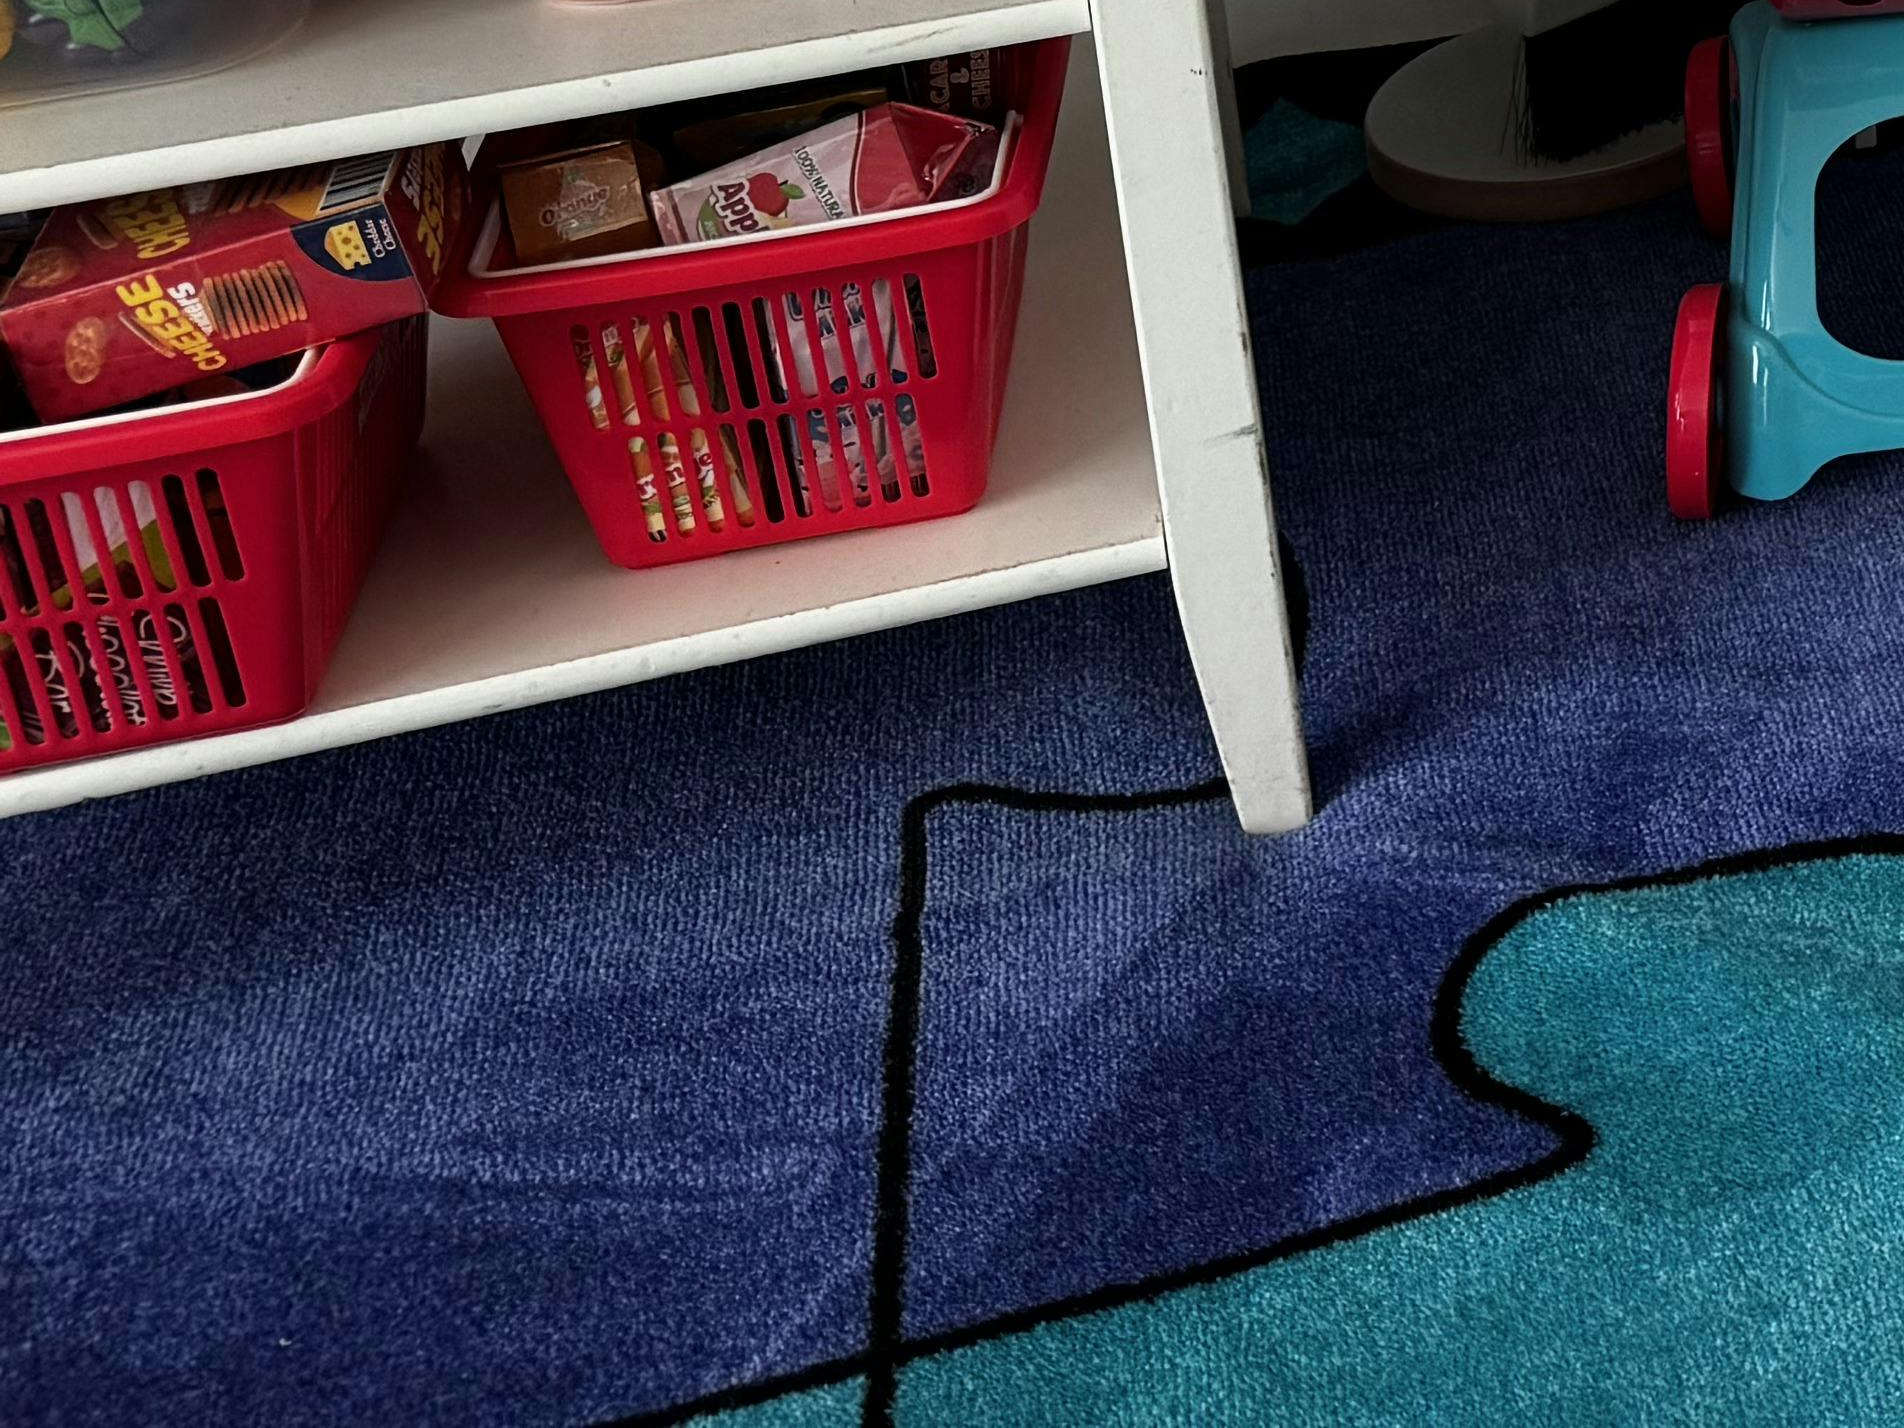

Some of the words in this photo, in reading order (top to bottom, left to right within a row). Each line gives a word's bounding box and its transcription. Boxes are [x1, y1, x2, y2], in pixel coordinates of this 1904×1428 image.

[970, 49, 991, 110] CHEES
[540, 186, 609, 227] Orange
[794, 145, 820, 181] 100%
[811, 172, 846, 220] NATURA
[364, 218, 387, 259] Cheddar
[115, 273, 228, 371] CHEESE
